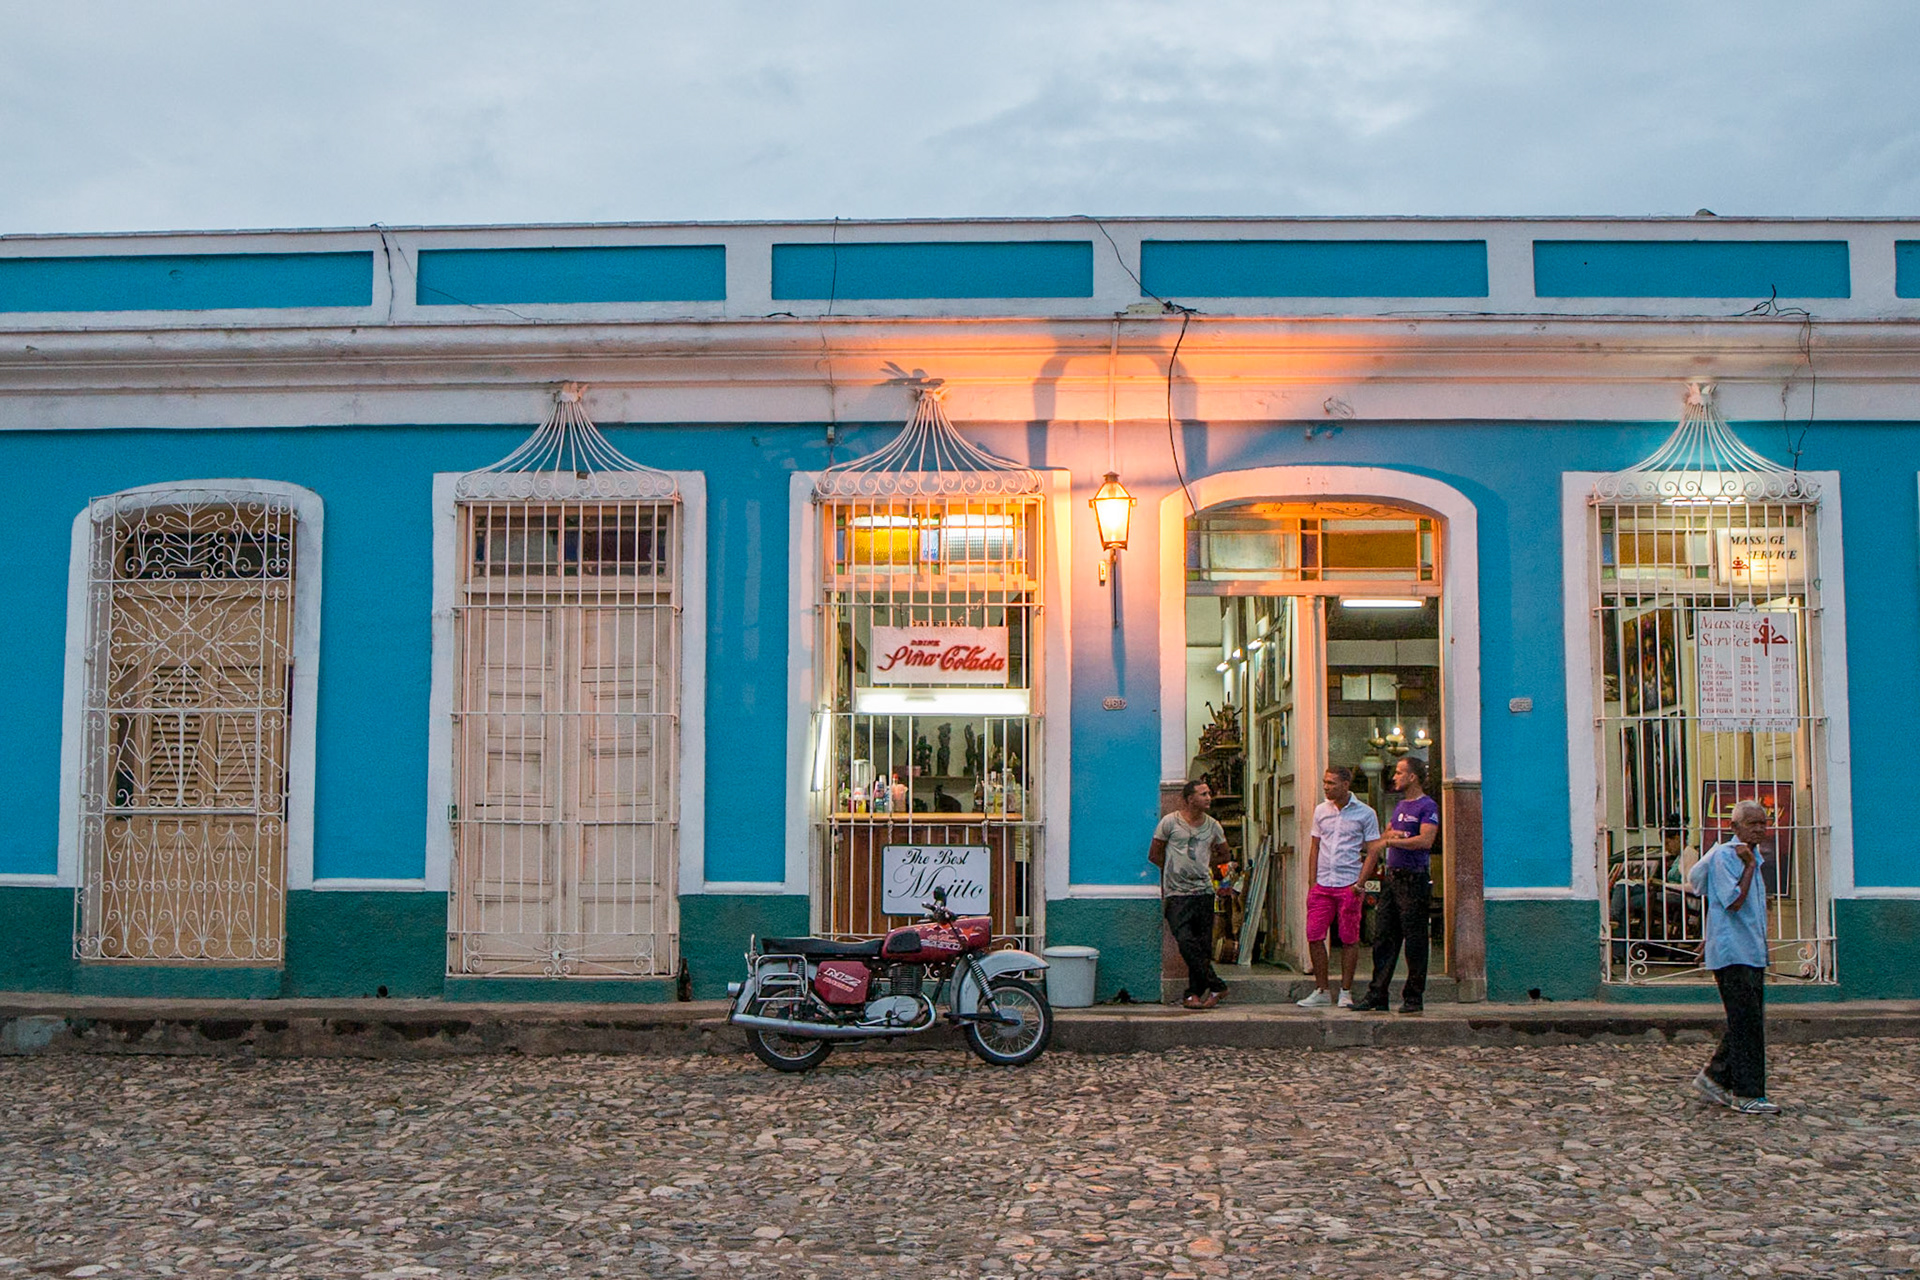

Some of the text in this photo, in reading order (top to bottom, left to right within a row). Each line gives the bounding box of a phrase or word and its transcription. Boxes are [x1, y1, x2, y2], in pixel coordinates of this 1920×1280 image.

[1700, 616, 1761, 633] Masage
[910, 639, 941, 647] DRINK
[902, 848, 970, 865] The Best
[887, 863, 984, 900] Mjito
